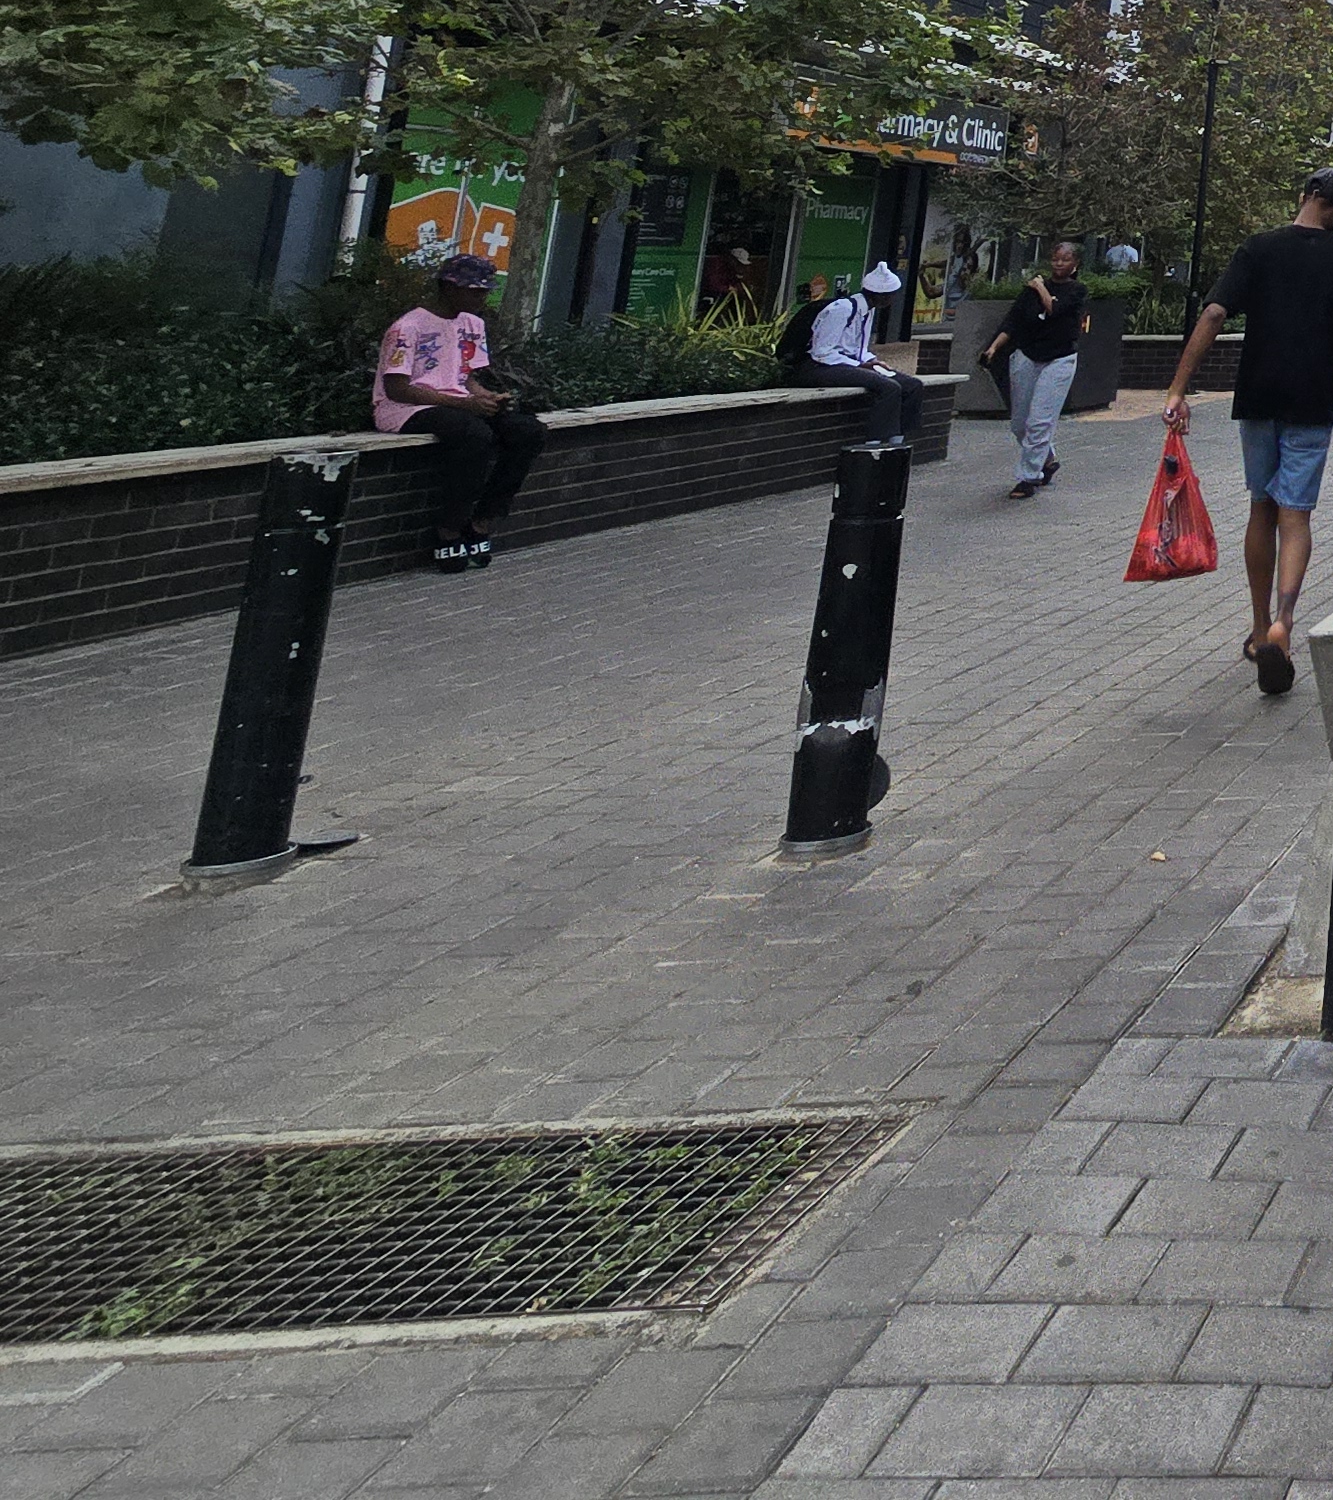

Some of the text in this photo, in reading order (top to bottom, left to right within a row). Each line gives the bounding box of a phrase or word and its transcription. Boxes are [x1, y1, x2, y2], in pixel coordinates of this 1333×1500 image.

[877, 112, 1005, 151] armacy & Clinic
[805, 197, 869, 225] Pharmacy
